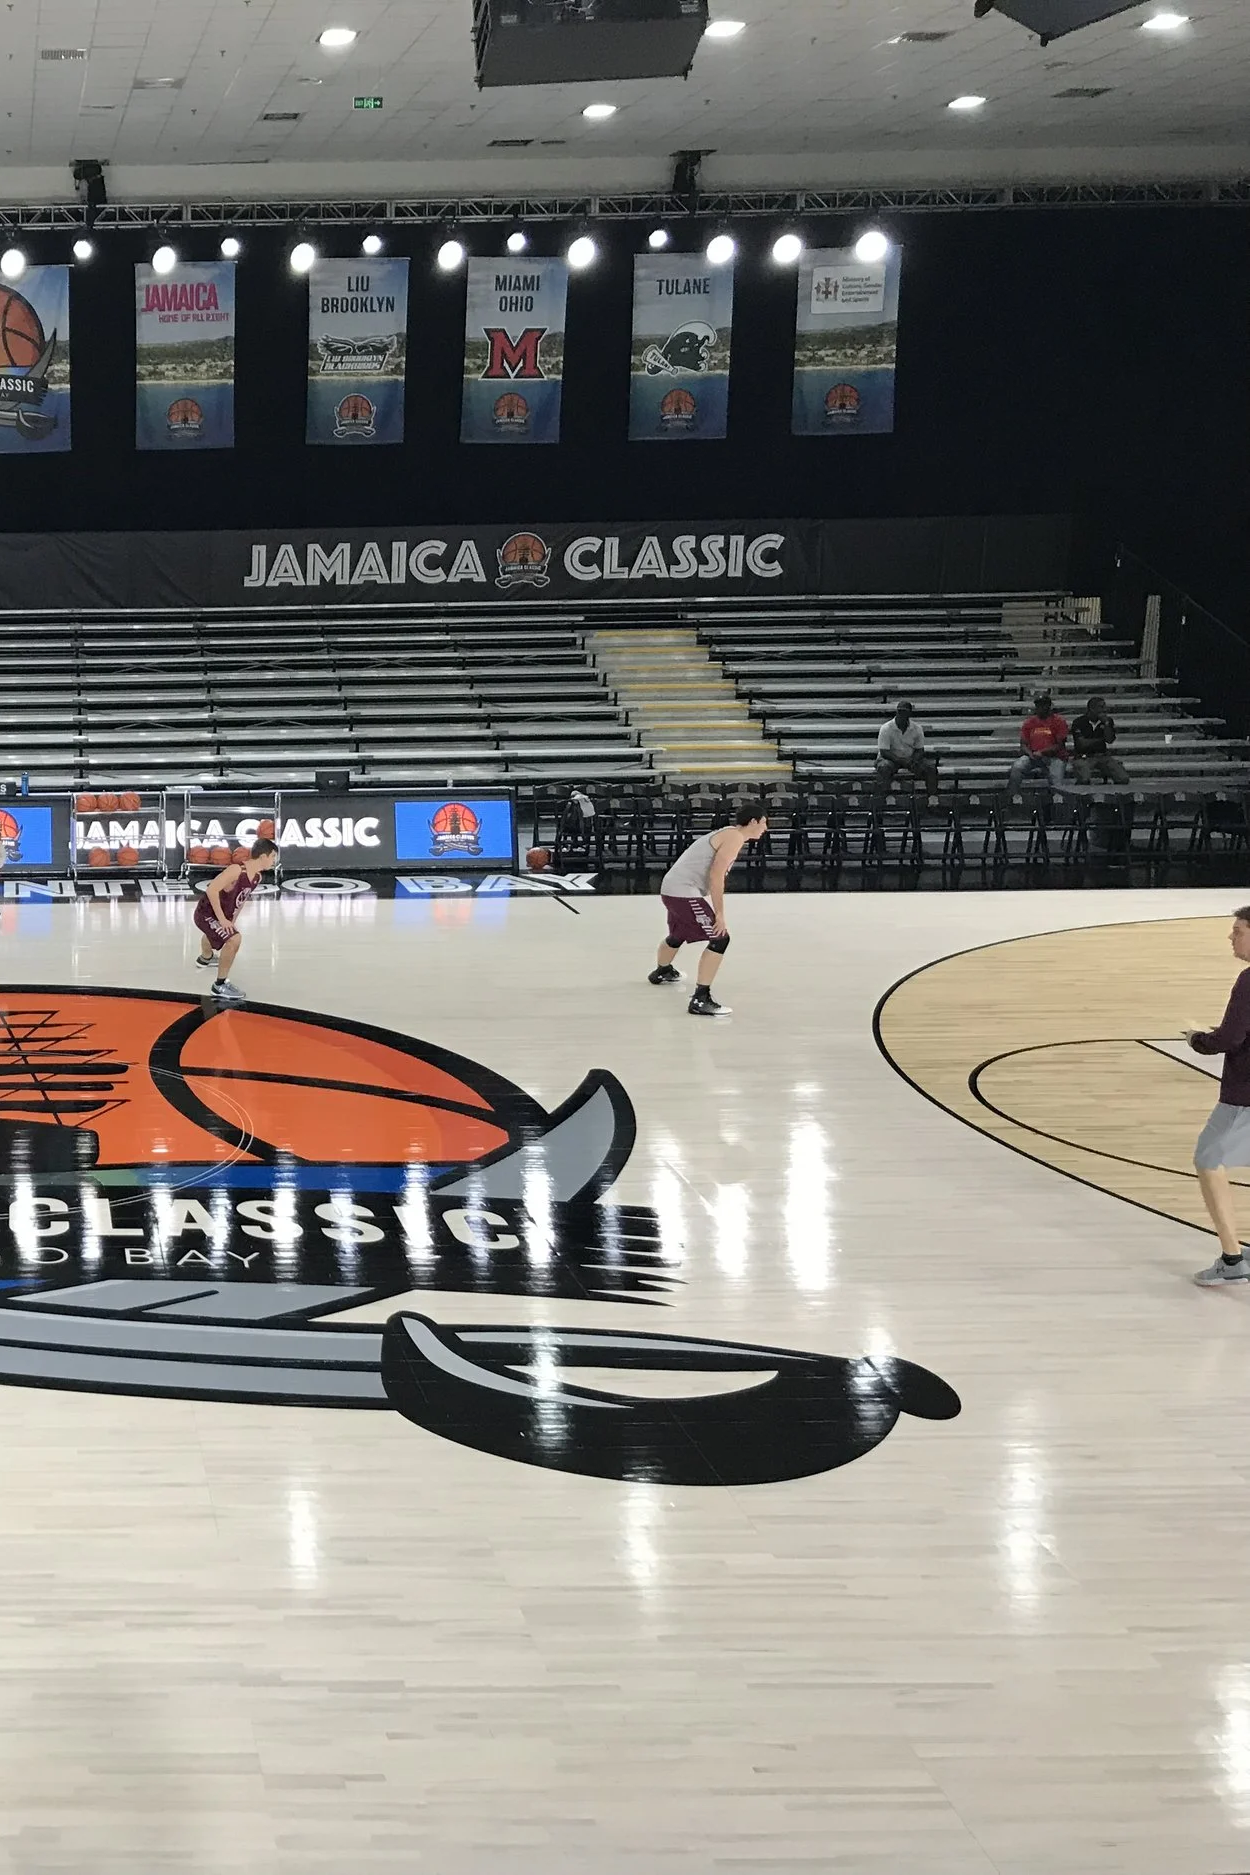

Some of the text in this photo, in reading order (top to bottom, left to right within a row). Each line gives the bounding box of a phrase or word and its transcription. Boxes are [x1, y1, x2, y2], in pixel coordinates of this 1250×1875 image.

[347, 275, 370, 292] LIU
[494, 274, 540, 292] MIAMI
[656, 278, 711, 296] TULANE
[141, 284, 219, 312] JAMAICA
[320, 295, 395, 314] BROOKLYN
[498, 295, 534, 314] OHIO
[478, 327, 549, 380] M
[243, 533, 785, 587] JAMAICA CLASSIC
[68, 817, 381, 849] JAMAICA CASSIC
[394, 872, 599, 894] BAY
[8, 1197, 520, 1249] CLASSIC
[123, 1246, 260, 1269] BAY
